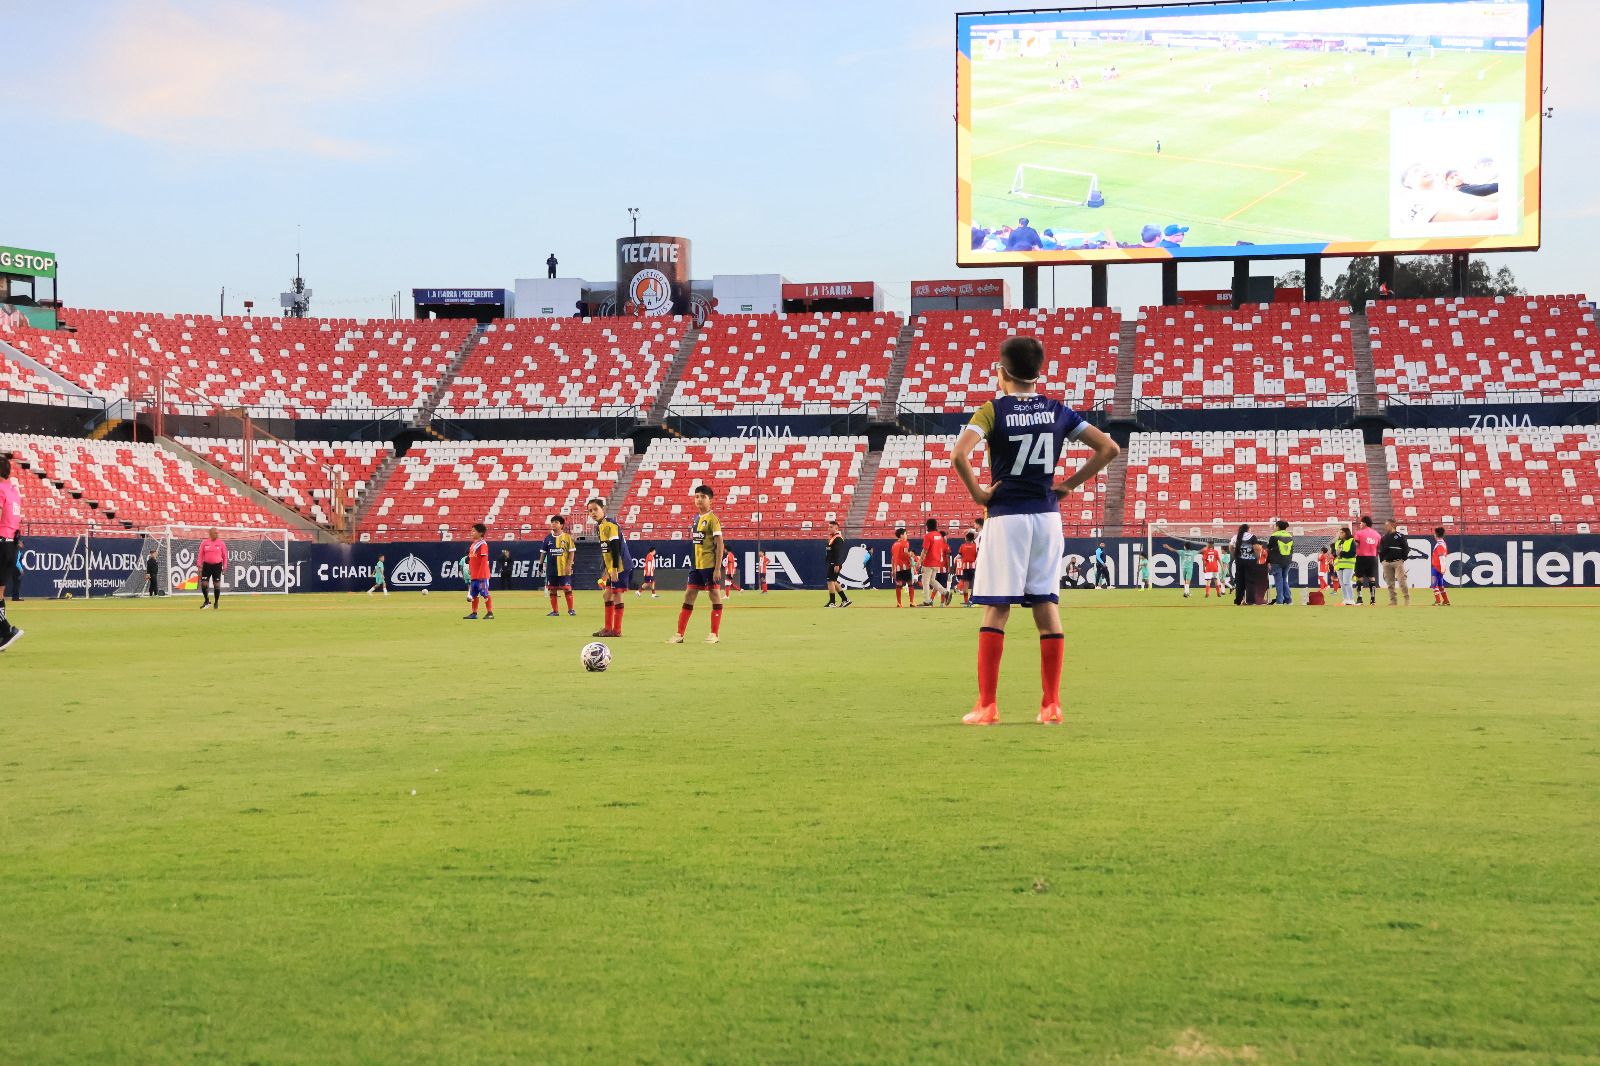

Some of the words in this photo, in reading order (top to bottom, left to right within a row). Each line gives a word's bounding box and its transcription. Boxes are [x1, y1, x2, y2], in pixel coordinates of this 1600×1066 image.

[621, 243, 680, 263] TECATE
[805, 286, 819, 297] LA
[822, 285, 853, 296] BARRA
[1468, 414, 1533, 428] ZONA
[736, 425, 792, 438] ZONA
[1008, 432, 1054, 476] 74
[23, 549, 85, 571] CIUDAD
[88, 550, 150, 571] MADERA
[234, 561, 302, 588] POTOSÍ
[397, 571, 427, 582] GVR
[511, 560, 531, 578] DE
[53, 579, 92, 588] TERRENOS
[94, 578, 126, 588] PREMIUM
